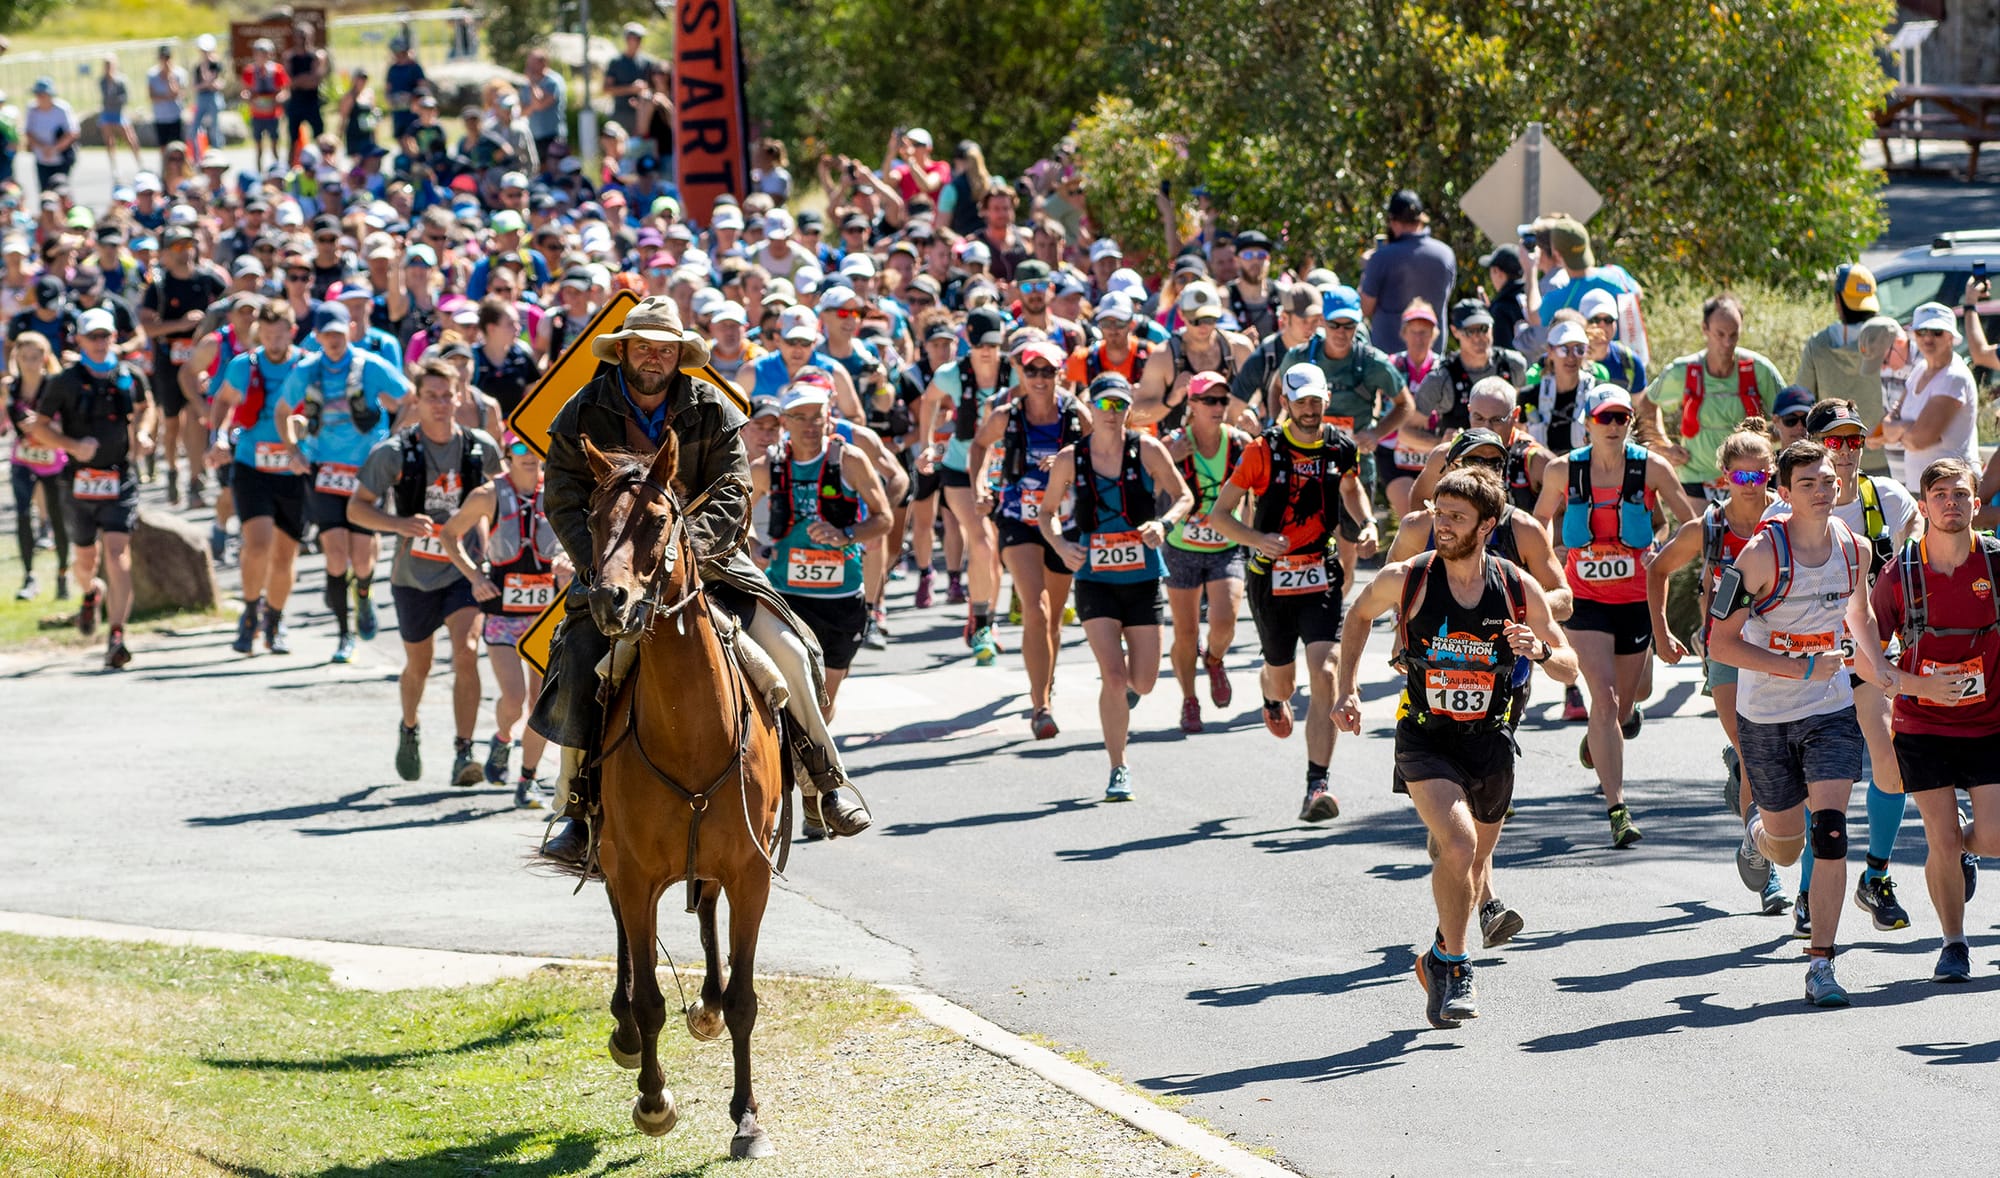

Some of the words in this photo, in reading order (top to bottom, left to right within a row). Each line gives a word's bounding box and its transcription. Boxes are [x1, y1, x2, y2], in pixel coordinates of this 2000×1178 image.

[681, 0, 735, 193] START
[420, 537, 442, 553] 11
[1097, 546, 1138, 564] 205
[795, 565, 837, 581] 357
[1583, 560, 1628, 578] 200
[1280, 568, 1320, 587] 276
[511, 588, 548, 604] 218
[1432, 641, 1493, 656] MARATHON
[1449, 638, 1469, 646] COAST
[1801, 644, 1832, 652] AUSTRALIA
[1441, 677, 1460, 685] TRAIL
[1434, 689, 1485, 711] 183
